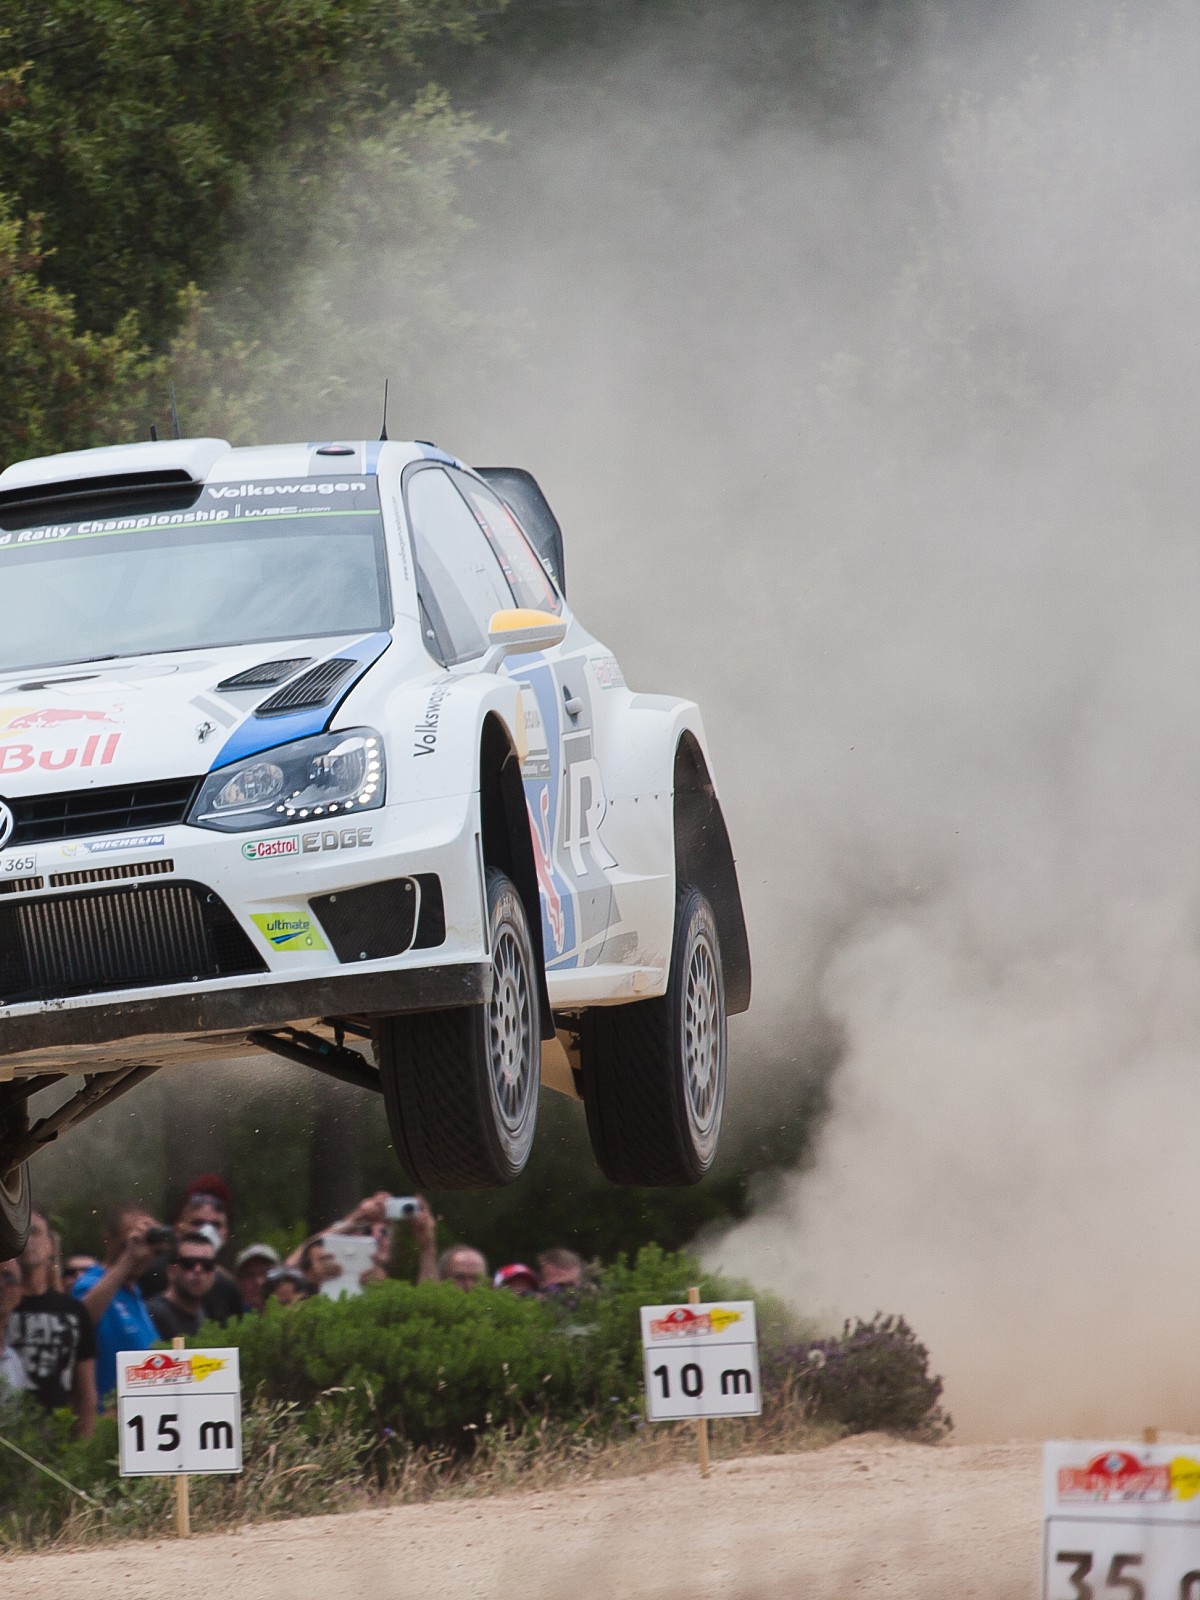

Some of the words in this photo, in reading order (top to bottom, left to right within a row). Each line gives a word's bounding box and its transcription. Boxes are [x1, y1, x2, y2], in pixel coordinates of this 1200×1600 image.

[207, 481, 367, 500] Volkswagen
[17, 525, 72, 544] Rally
[77, 507, 230, 535] Championship
[91, 835, 163, 852] MICHELIN
[257, 838, 297, 857] Castrol
[302, 827, 373, 854] EDGE
[5, 857, 35, 872] 365
[266, 919, 310, 931] ultimate
[652, 1363, 703, 1399] 10
[720, 1367, 753, 1396] m
[126, 1413, 181, 1453] 15
[199, 1419, 233, 1451] m
[1056, 1551, 1146, 1600] 35
